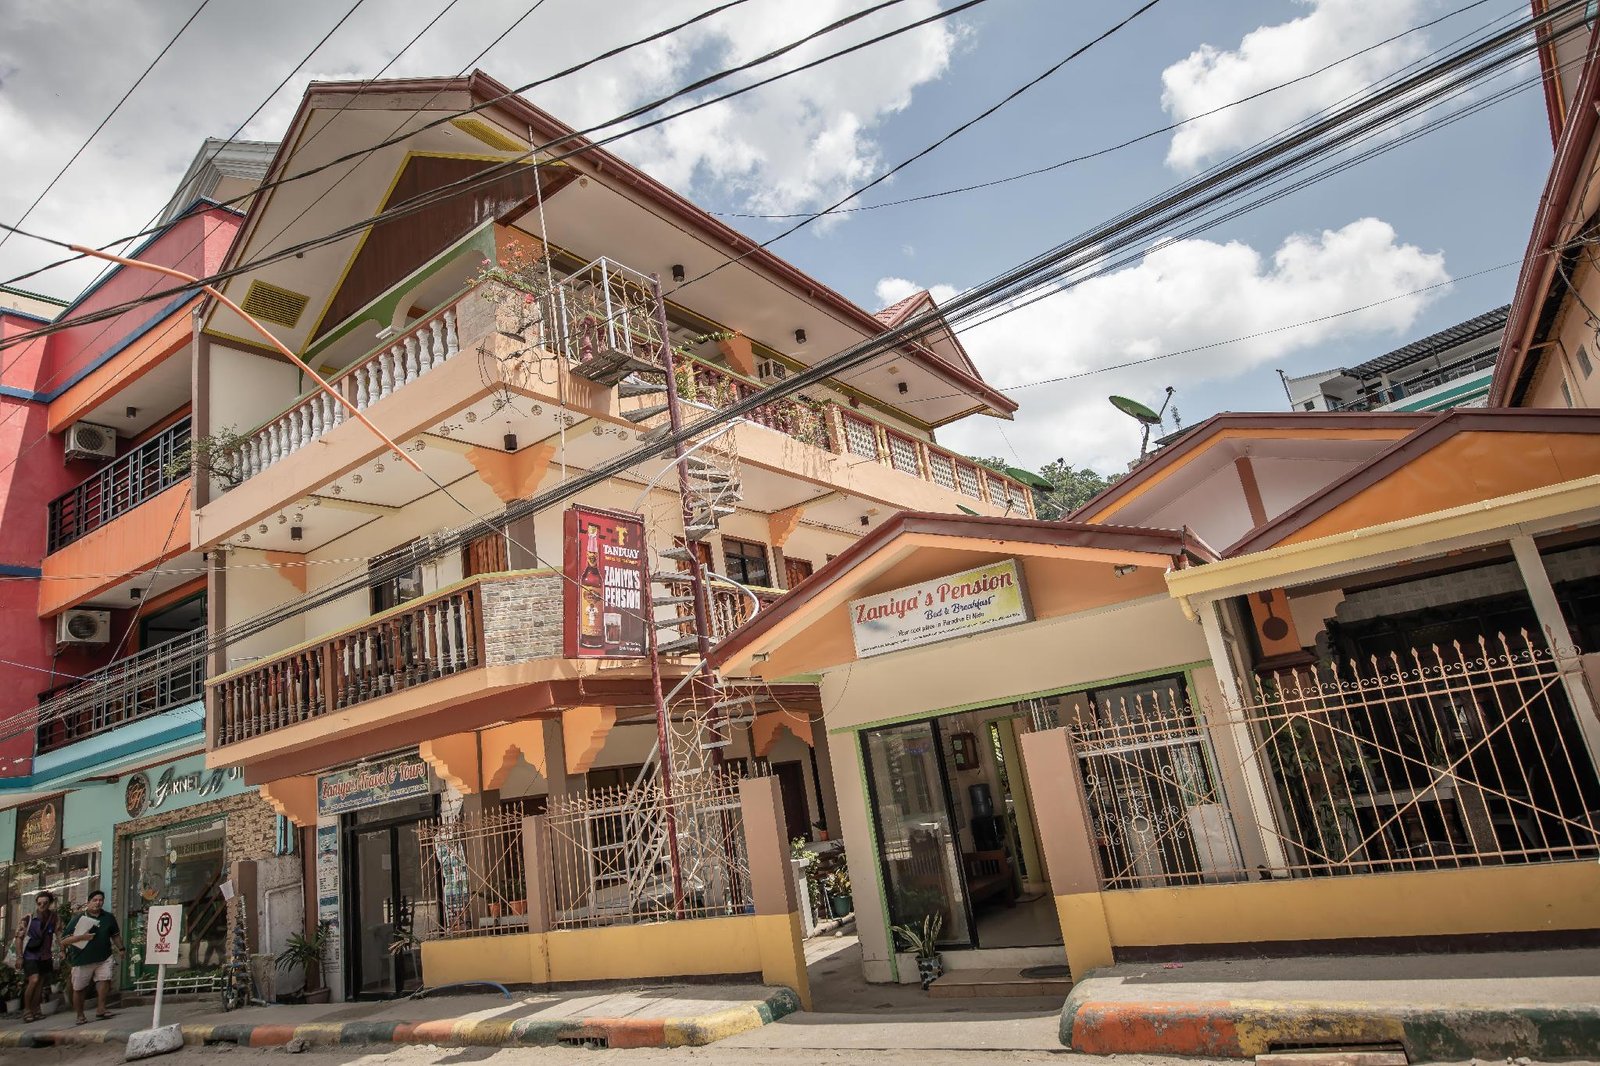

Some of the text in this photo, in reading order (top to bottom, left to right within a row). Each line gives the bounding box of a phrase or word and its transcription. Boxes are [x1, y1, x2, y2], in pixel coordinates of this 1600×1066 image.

[603, 544, 640, 559] TANDUAY
[604, 565, 641, 590] ZANIYA'S
[604, 587, 641, 610] PENSION
[855, 572, 1013, 624] Zaniya's Pension
[924, 595, 996, 621] Bed & Breakfast
[972, 612, 985, 620] Nido
[358, 766, 388, 791] Travel
[388, 763, 397, 784] &
[398, 761, 426, 782] Tours
